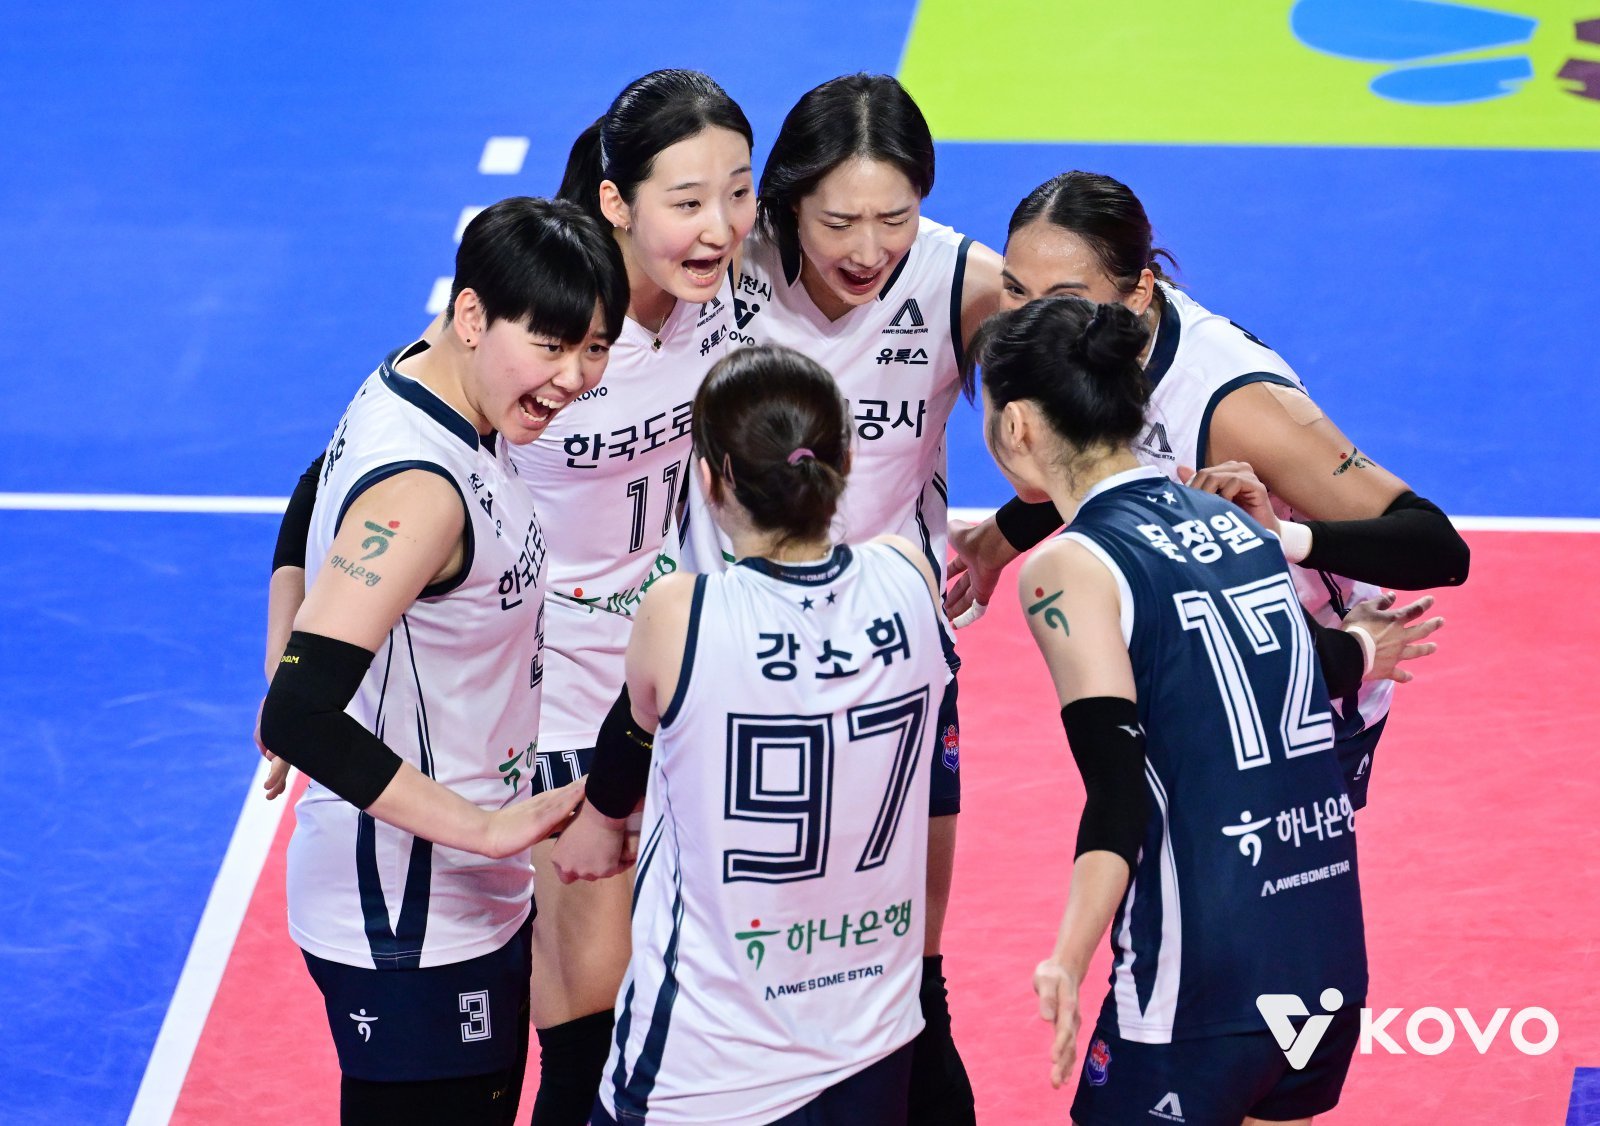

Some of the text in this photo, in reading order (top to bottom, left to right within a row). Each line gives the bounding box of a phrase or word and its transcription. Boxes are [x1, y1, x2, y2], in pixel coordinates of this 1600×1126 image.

[729, 331, 755, 347] OVO
[876, 347, 929, 365] 유록스
[844, 398, 926, 441] 공사
[626, 460, 681, 554] 11
[498, 513, 547, 611] 한국도로
[1136, 510, 1264, 563] 문정원
[756, 611, 911, 681] 강소휘
[1172, 572, 1335, 770] 12
[723, 684, 930, 884] 97
[1276, 860, 1351, 891] AWESOME STAR
[787, 899, 912, 955] 하나은행
[777, 964, 883, 997] AWESOME STAR
[458, 989, 492, 1043] 3
